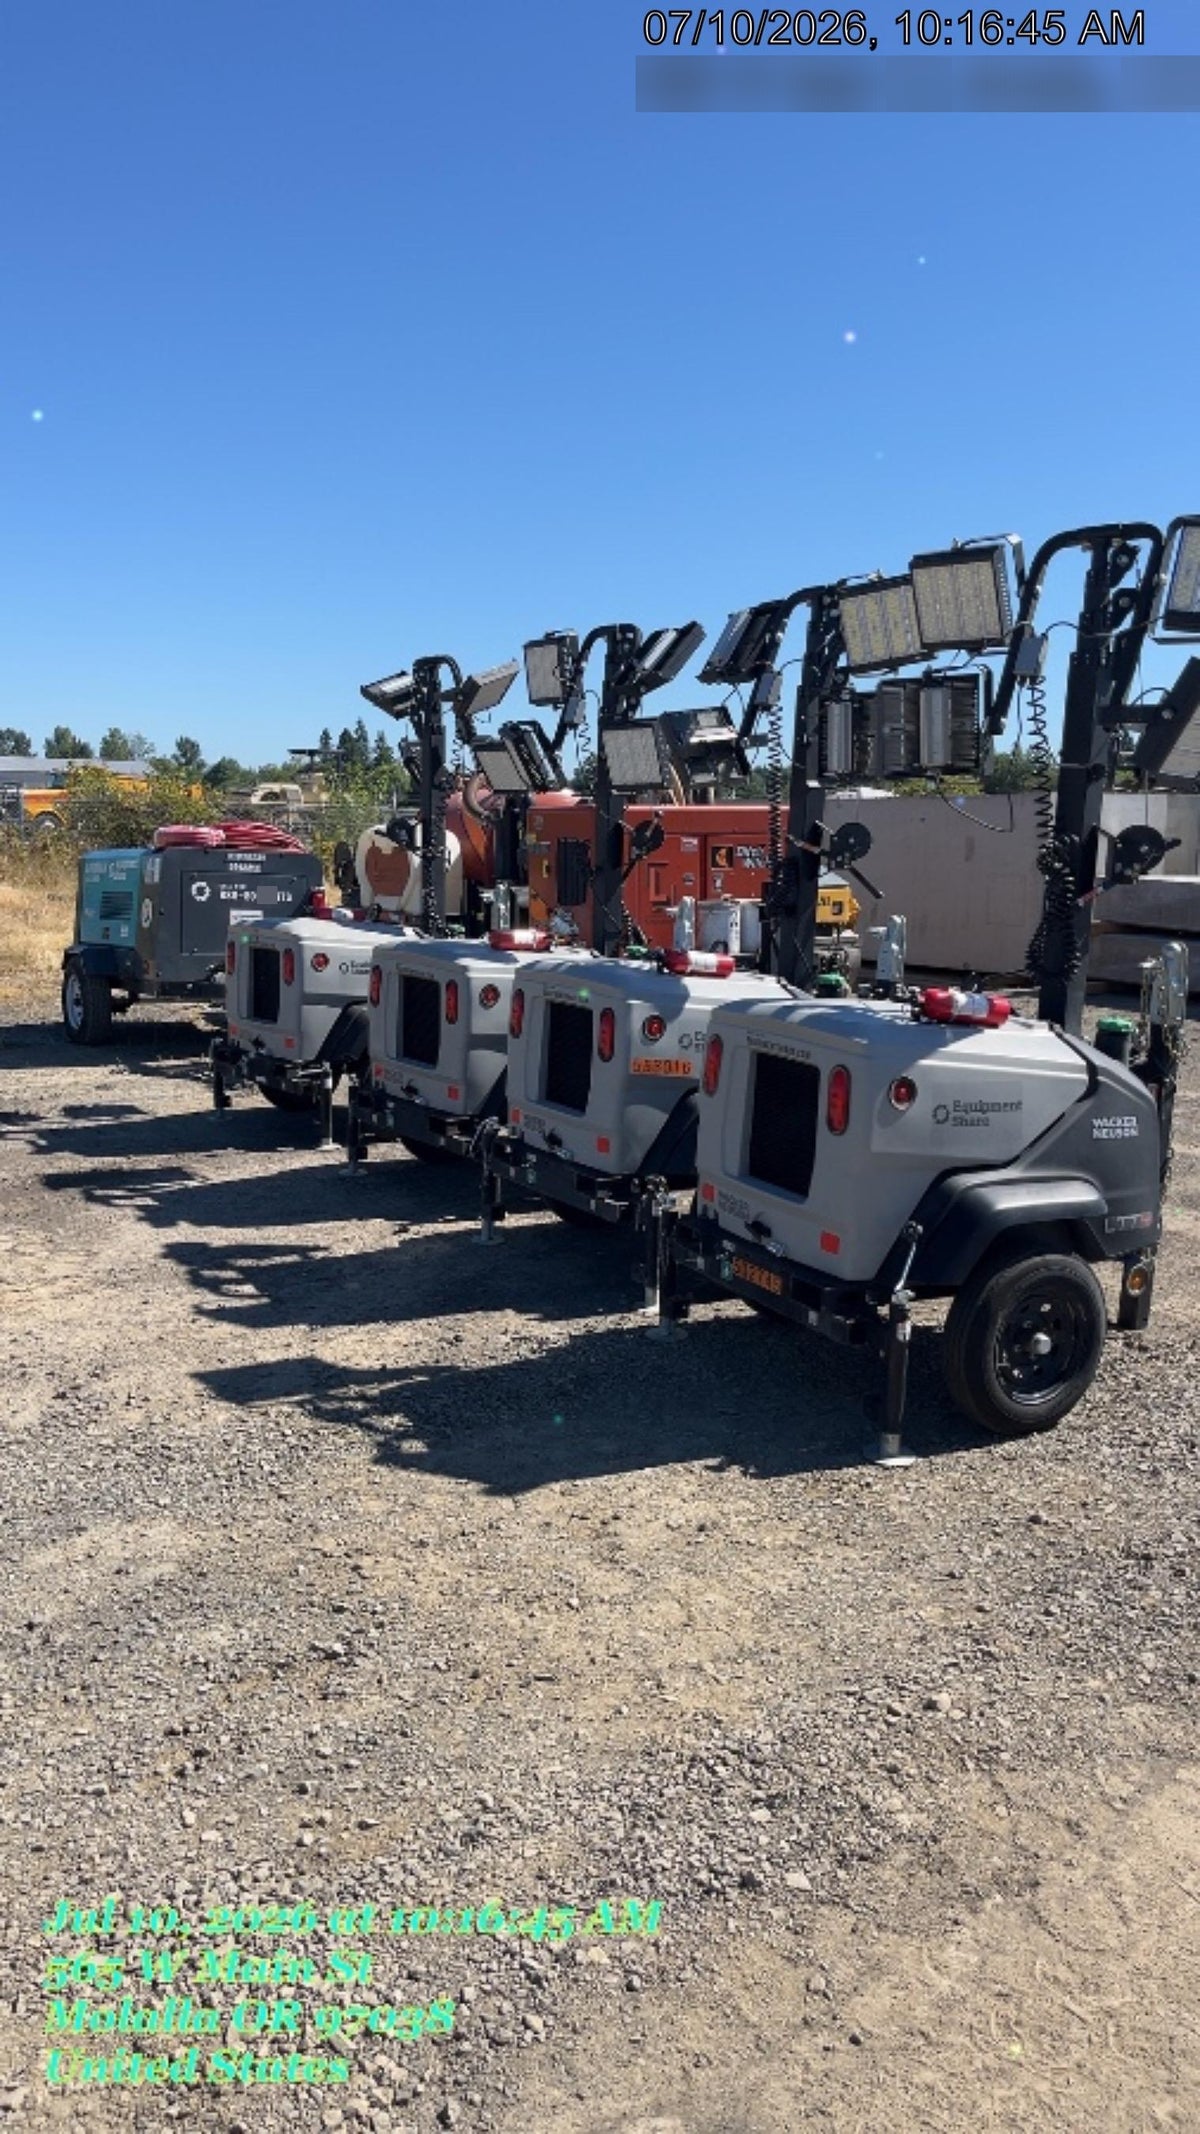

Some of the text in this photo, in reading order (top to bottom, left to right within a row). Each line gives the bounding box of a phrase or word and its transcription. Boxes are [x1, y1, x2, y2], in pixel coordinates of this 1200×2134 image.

[953, 1100, 1023, 1114] Equipment
[951, 1116, 990, 1127] Share
[1092, 1116, 1137, 1128] WACKER
[1092, 1127, 1139, 1139] NEUSON
